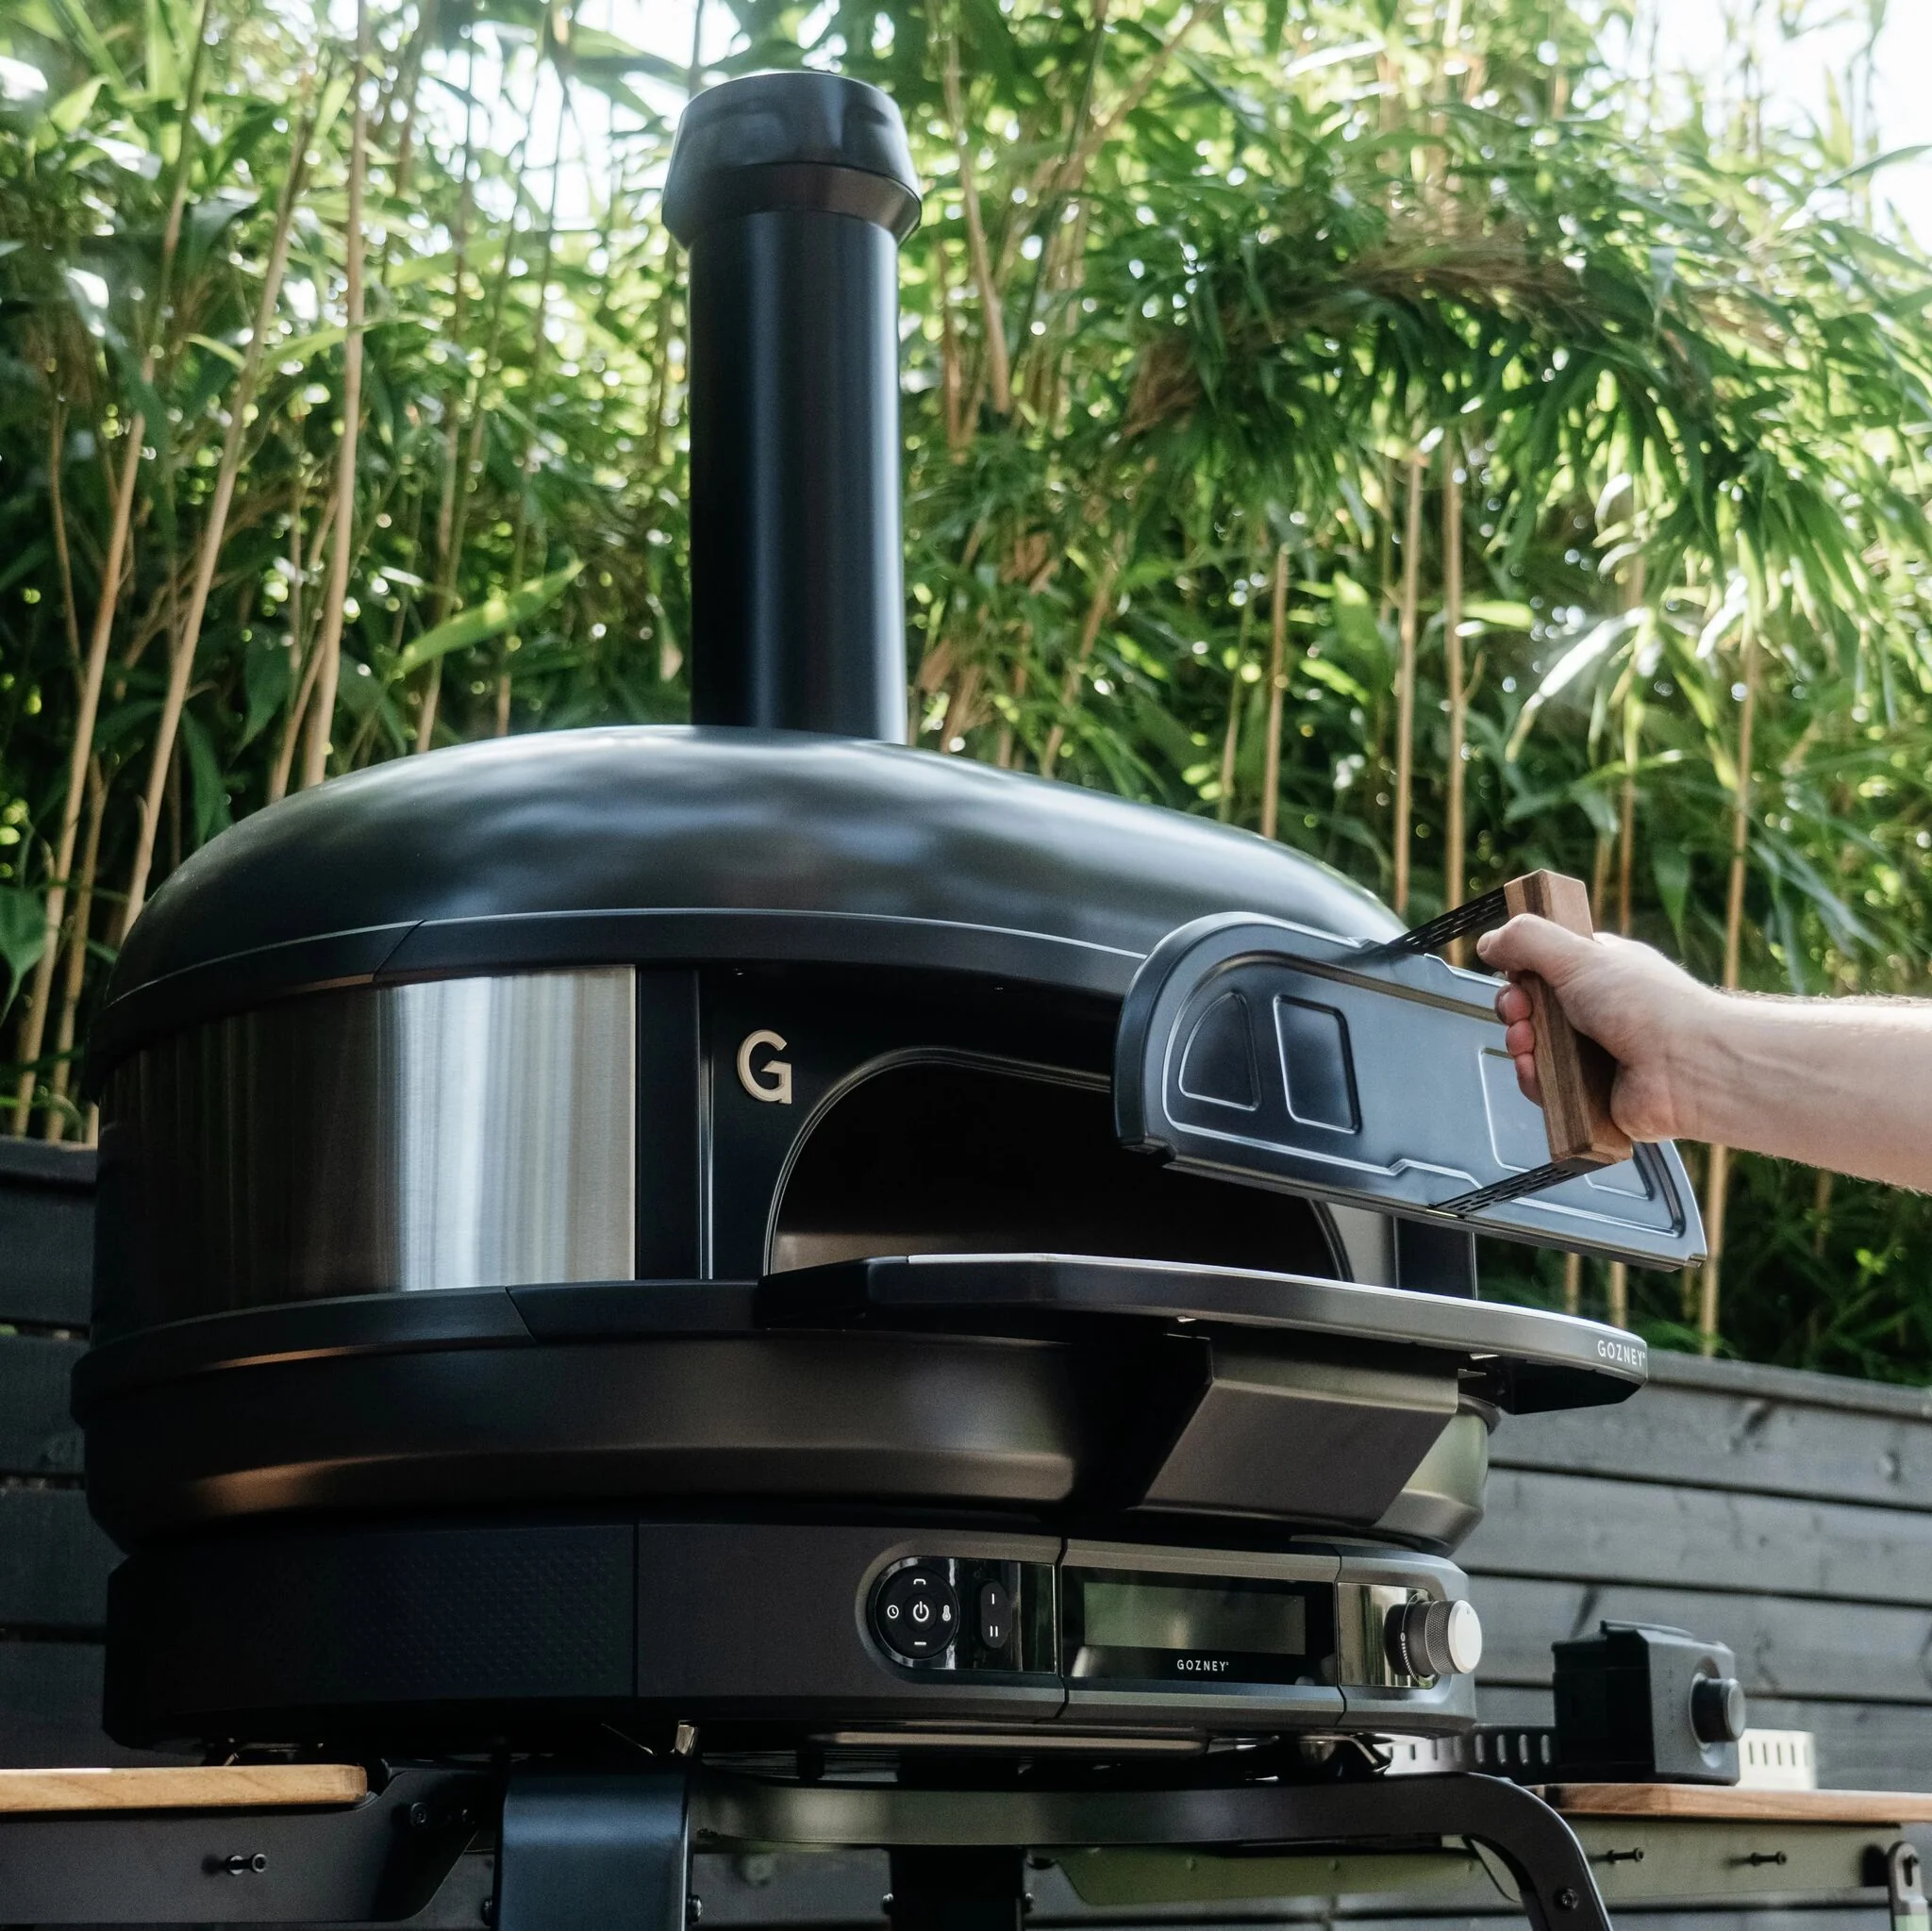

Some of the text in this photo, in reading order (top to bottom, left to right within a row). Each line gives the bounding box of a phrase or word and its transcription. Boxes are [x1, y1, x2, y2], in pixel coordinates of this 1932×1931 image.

[737, 1029, 792, 1105] G
[1597, 1340, 1643, 1367] GOZNEY
[1176, 1659, 1226, 1673] GOZNEY
